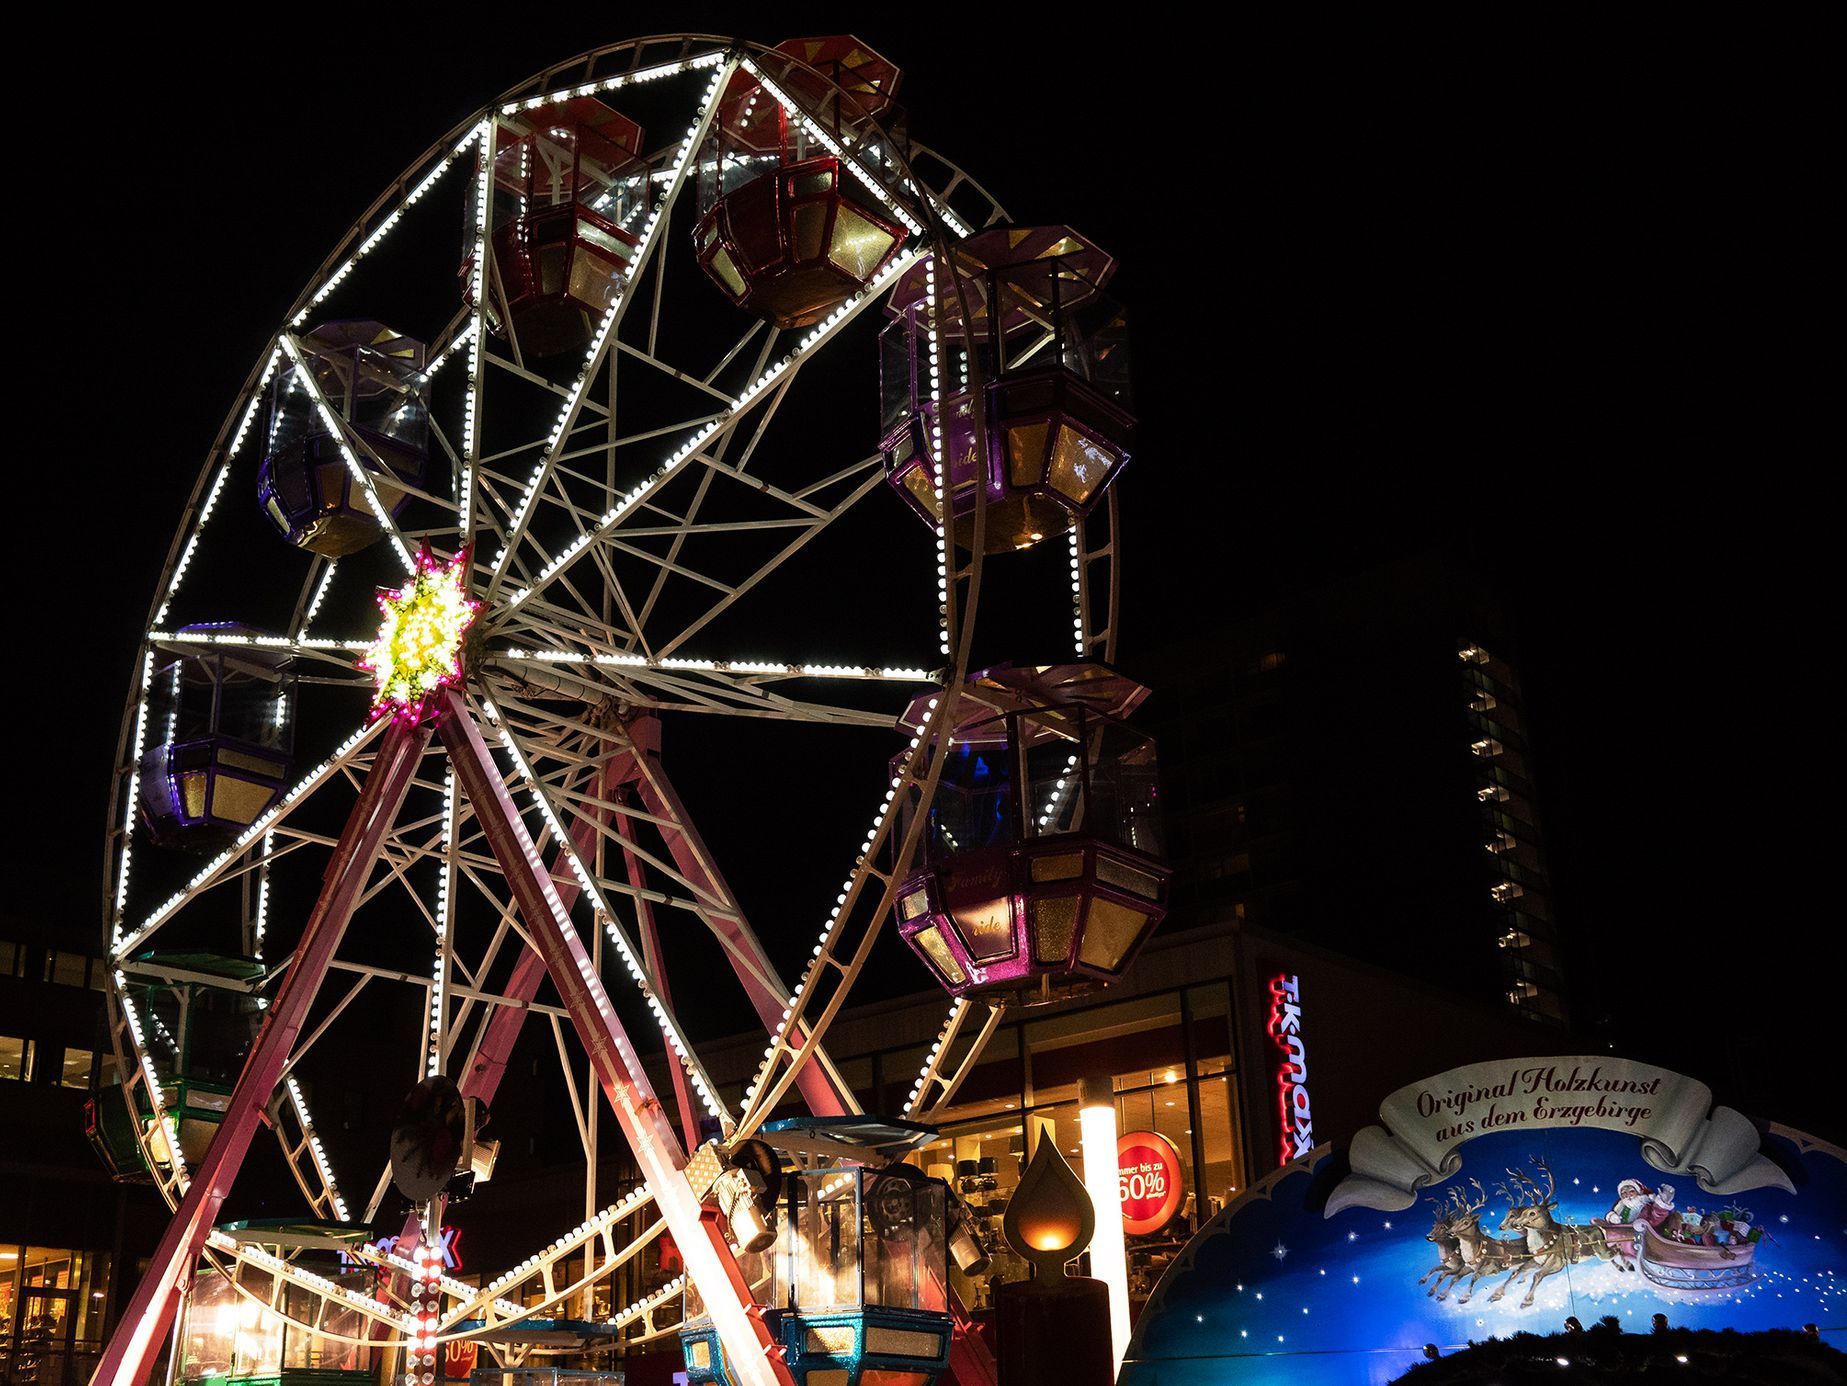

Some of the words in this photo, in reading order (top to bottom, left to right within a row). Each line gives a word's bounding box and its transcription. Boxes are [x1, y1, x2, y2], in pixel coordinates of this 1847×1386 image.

[1416, 1070, 1519, 1118] Original
[1521, 1066, 1662, 1096] Holzkunst
[1435, 1121, 1475, 1142] aus
[1481, 1103, 1527, 1129] dem
[1533, 1095, 1652, 1127] Erzgebirge
[1140, 1163, 1152, 1172] bis
[1153, 1162, 1163, 1171] zu
[1119, 1172, 1165, 1202] 60%
